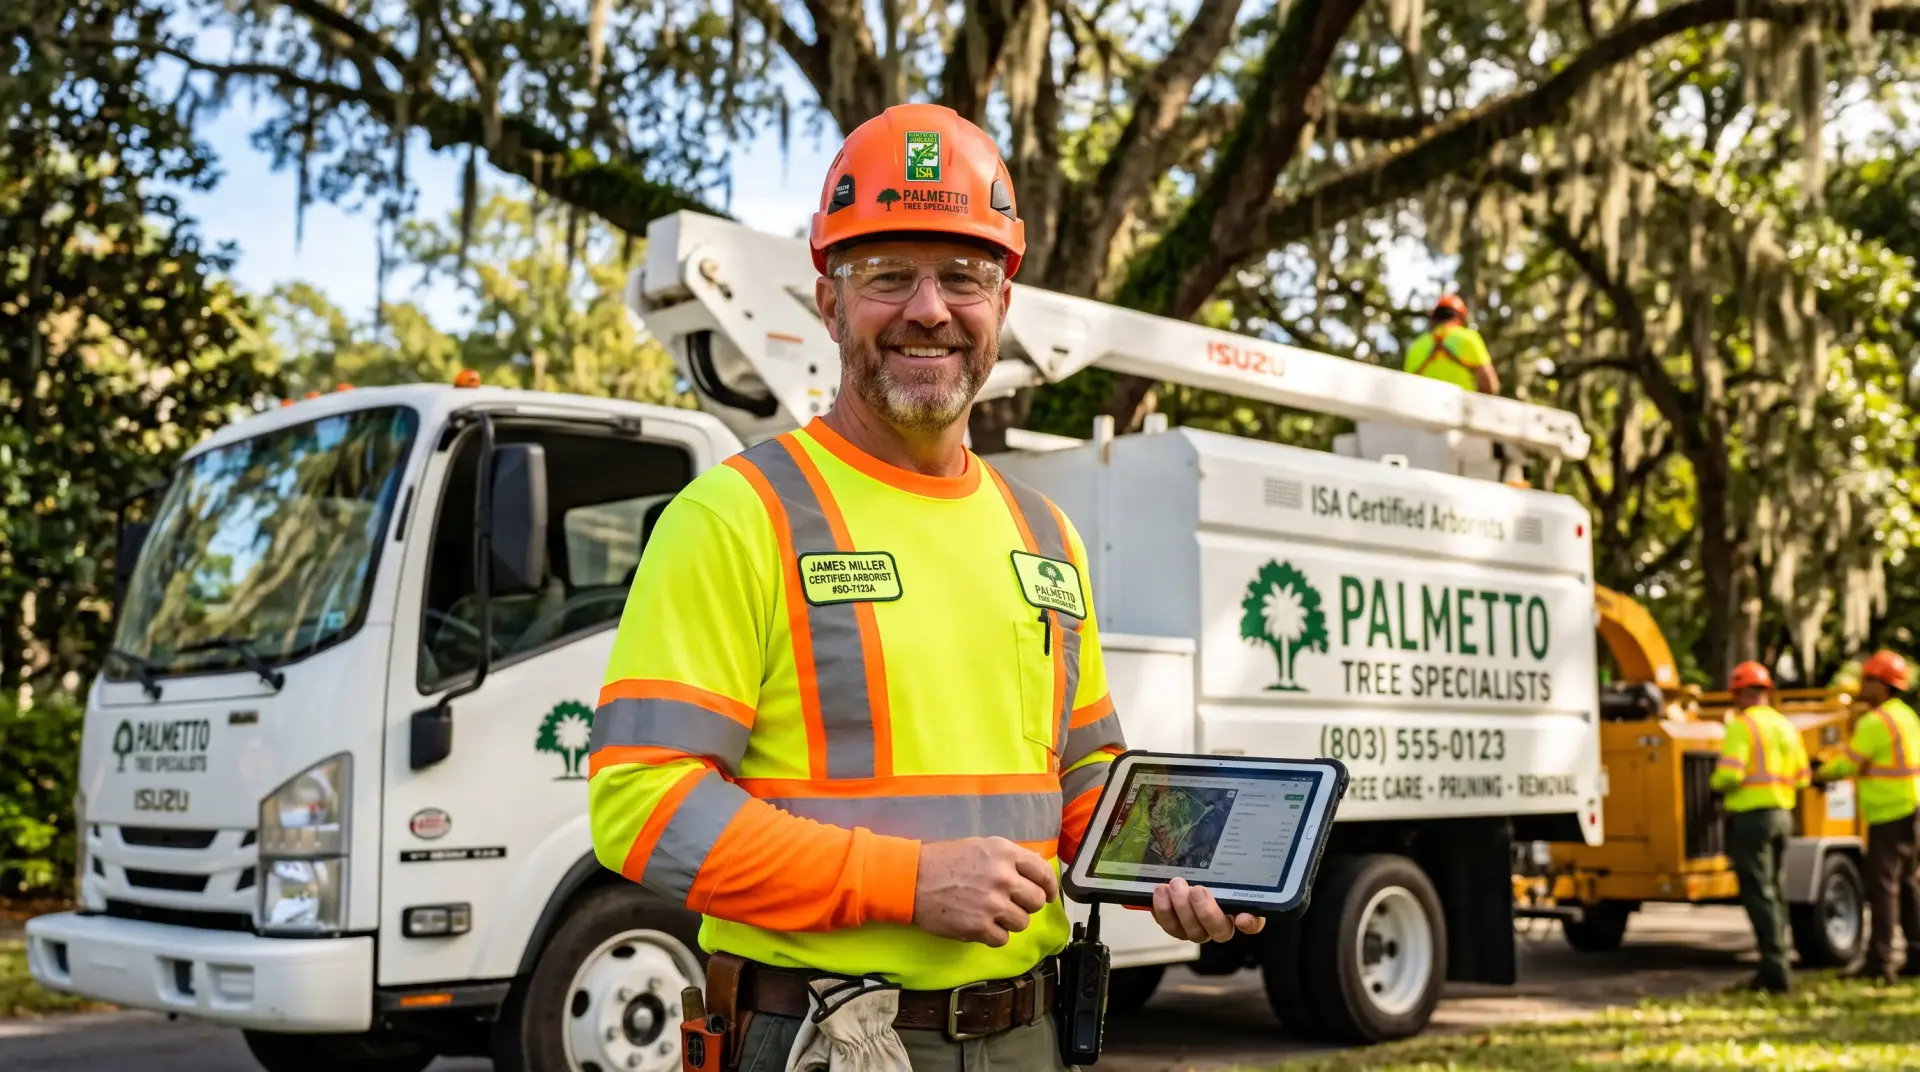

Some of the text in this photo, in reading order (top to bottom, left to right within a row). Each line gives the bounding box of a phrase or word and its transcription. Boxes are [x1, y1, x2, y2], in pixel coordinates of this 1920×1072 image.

[915, 167, 934, 178] ISA
[903, 189, 969, 206] PALMETTO
[903, 202, 969, 214] TREE SPECIALISTS
[1207, 341, 1286, 378] ISUZU
[1311, 485, 1342, 518] ISA
[1348, 489, 1425, 530] Certified
[809, 572, 892, 585] CERTIFIED ARBORIST
[810, 560, 887, 573] JAMES MILLER
[832, 584, 876, 595] #SO-7123A
[1034, 584, 1076, 604] PALMETTO
[1340, 574, 1550, 662] PALMETTO
[1341, 660, 1551, 702] TREE SPECIALISTS
[136, 718, 211, 752] PALMETTO
[1319, 724, 1507, 765] (803) 555-0123
[134, 787, 190, 812] ISUZU
[1347, 776, 1378, 801] REE
[1383, 775, 1423, 801] CARE
